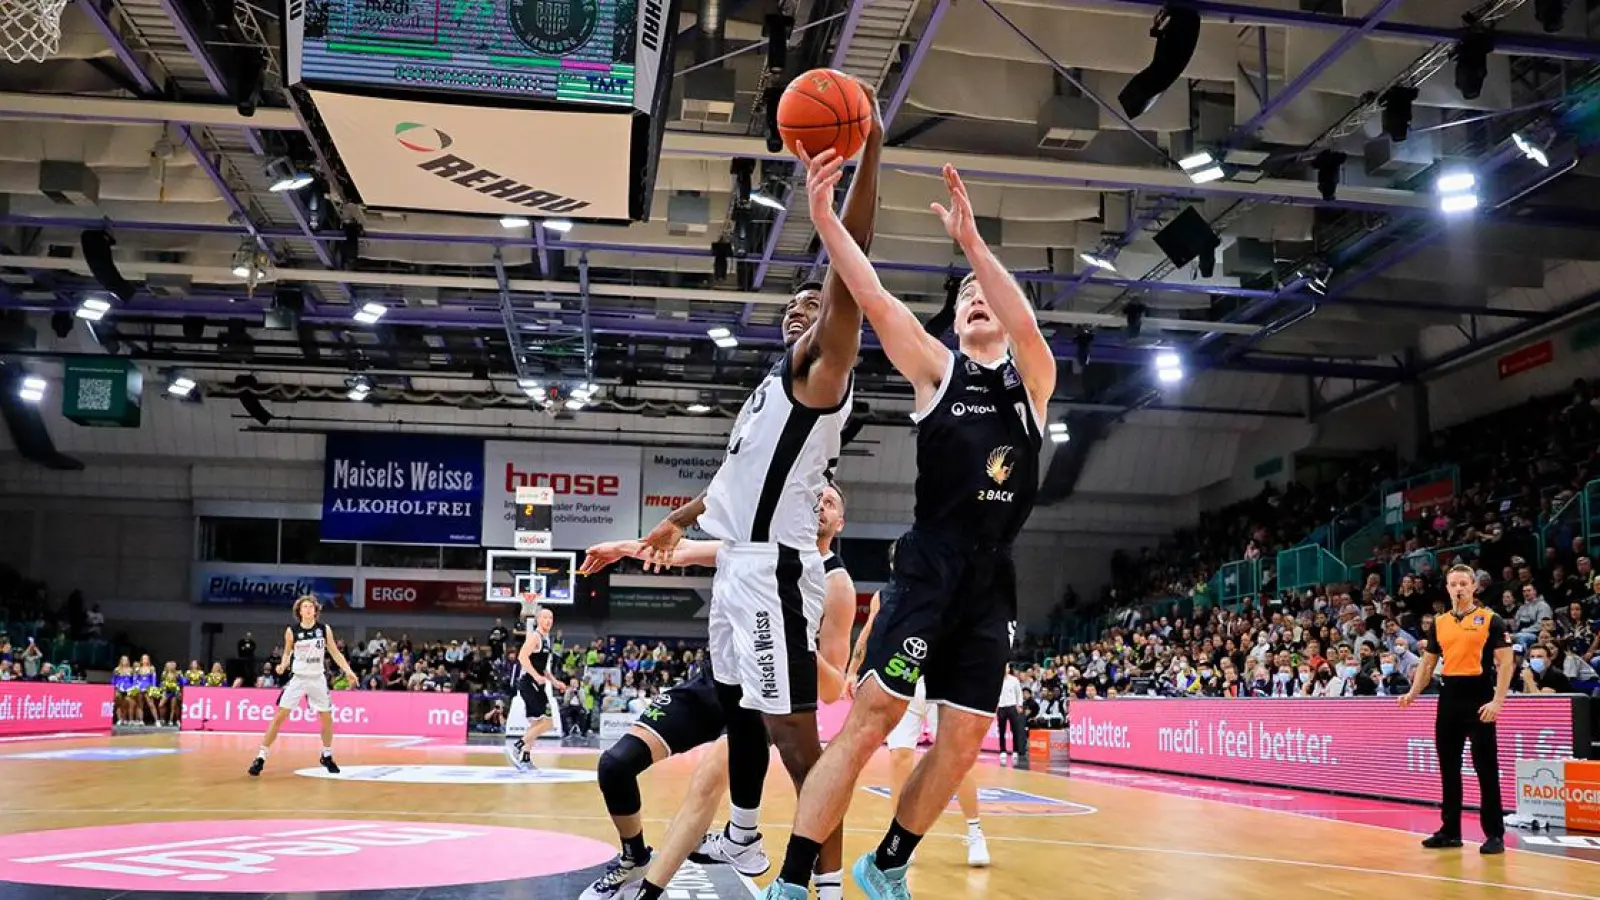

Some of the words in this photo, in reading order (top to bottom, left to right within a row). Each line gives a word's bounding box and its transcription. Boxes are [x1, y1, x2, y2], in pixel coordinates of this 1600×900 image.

[418, 154, 591, 214] REHAU
[333, 459, 405, 489] Maisel's
[410, 462, 474, 491] Weisse
[505, 462, 620, 496] brose
[679, 470, 694, 479] für
[332, 497, 471, 517] ALKOHOLFREI
[977, 490, 985, 501] 2
[986, 490, 1014, 502] BACK
[504, 512, 517, 521] de
[553, 514, 613, 524] obilindustrie
[576, 503, 611, 513] Partner
[209, 576, 312, 595] Piotrowski
[372, 587, 417, 602] ERGO
[753, 610, 774, 652] Weisse
[760, 653, 779, 698] Maisel's
[23, 694, 45, 719] feel
[48, 695, 83, 719] better.
[225, 701, 230, 720] I
[237, 700, 274, 721] fee
[1088, 717, 1131, 748] better.
[1159, 720, 1204, 755] medi.
[1209, 723, 1214, 754] I
[1217, 720, 1253, 758] feel
[1259, 721, 1339, 765] better.
